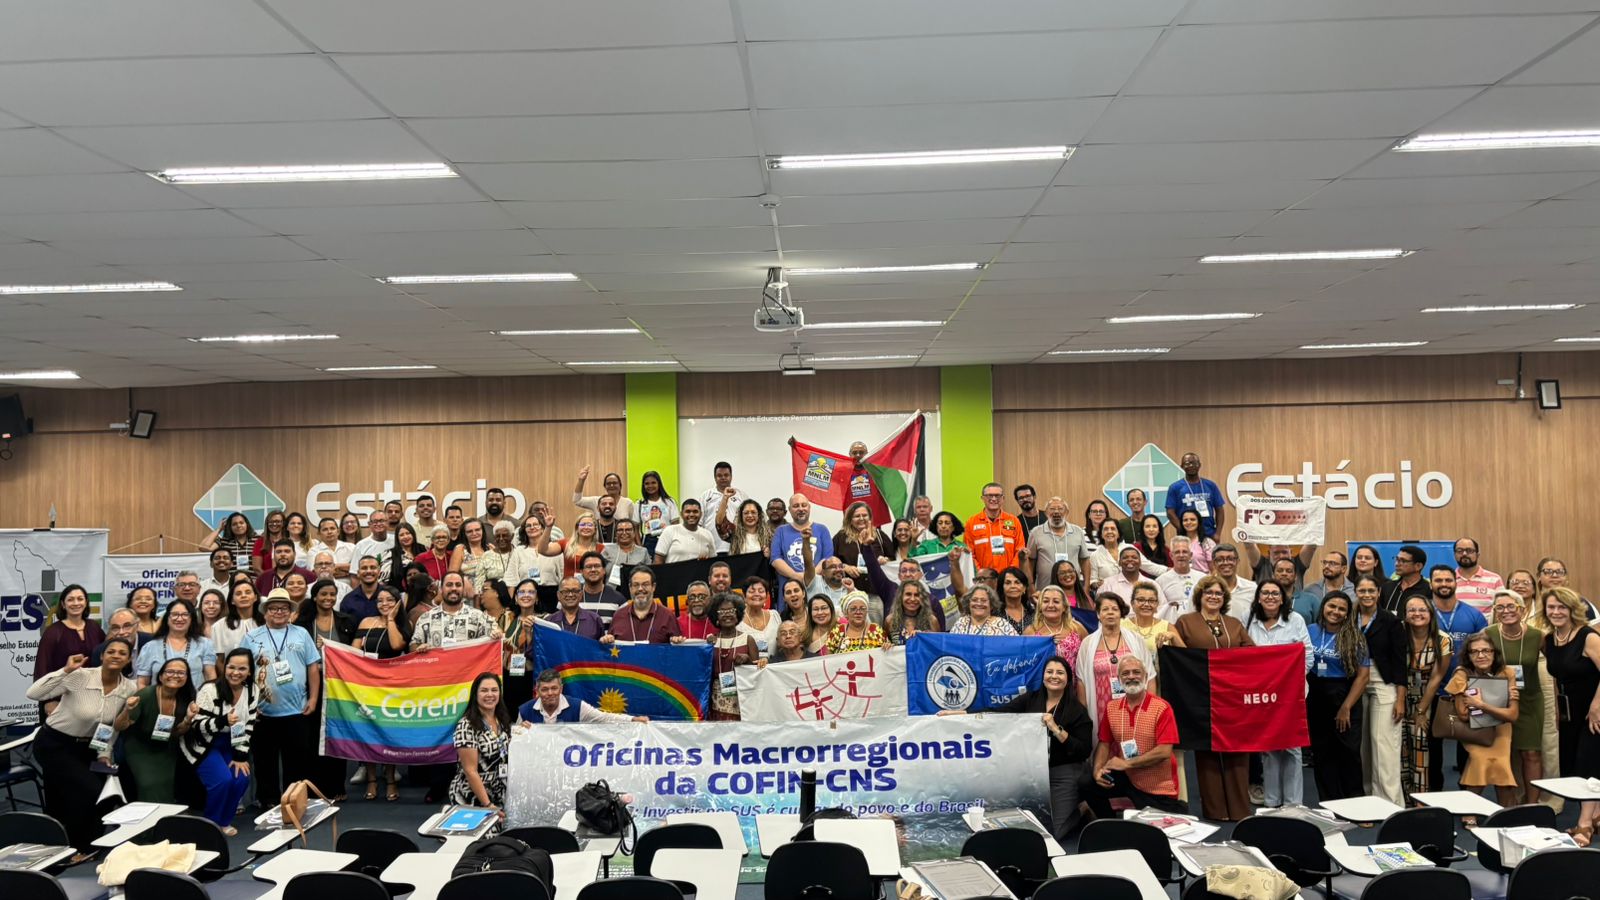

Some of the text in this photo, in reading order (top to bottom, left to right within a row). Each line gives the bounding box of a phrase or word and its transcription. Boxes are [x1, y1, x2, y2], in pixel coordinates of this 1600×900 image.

[757, 415, 790, 423] Educação
[807, 470, 830, 481] MNLM
[1226, 459, 1453, 509] Estácio
[306, 479, 527, 529] Estácio
[0, 594, 44, 631] ES
[0, 641, 16, 649] selho
[381, 693, 457, 718] Coren
[990, 694, 1010, 704] SUS
[1243, 692, 1277, 704] NEGO
[563, 733, 992, 768] Oficinas Macrorregionais
[655, 768, 897, 795] da COFIN-CNS
[730, 805, 761, 817] SUS
[858, 804, 896, 818] povo
[900, 803, 910, 813] e
[914, 801, 934, 813] do
[939, 799, 985, 813] Brasil
